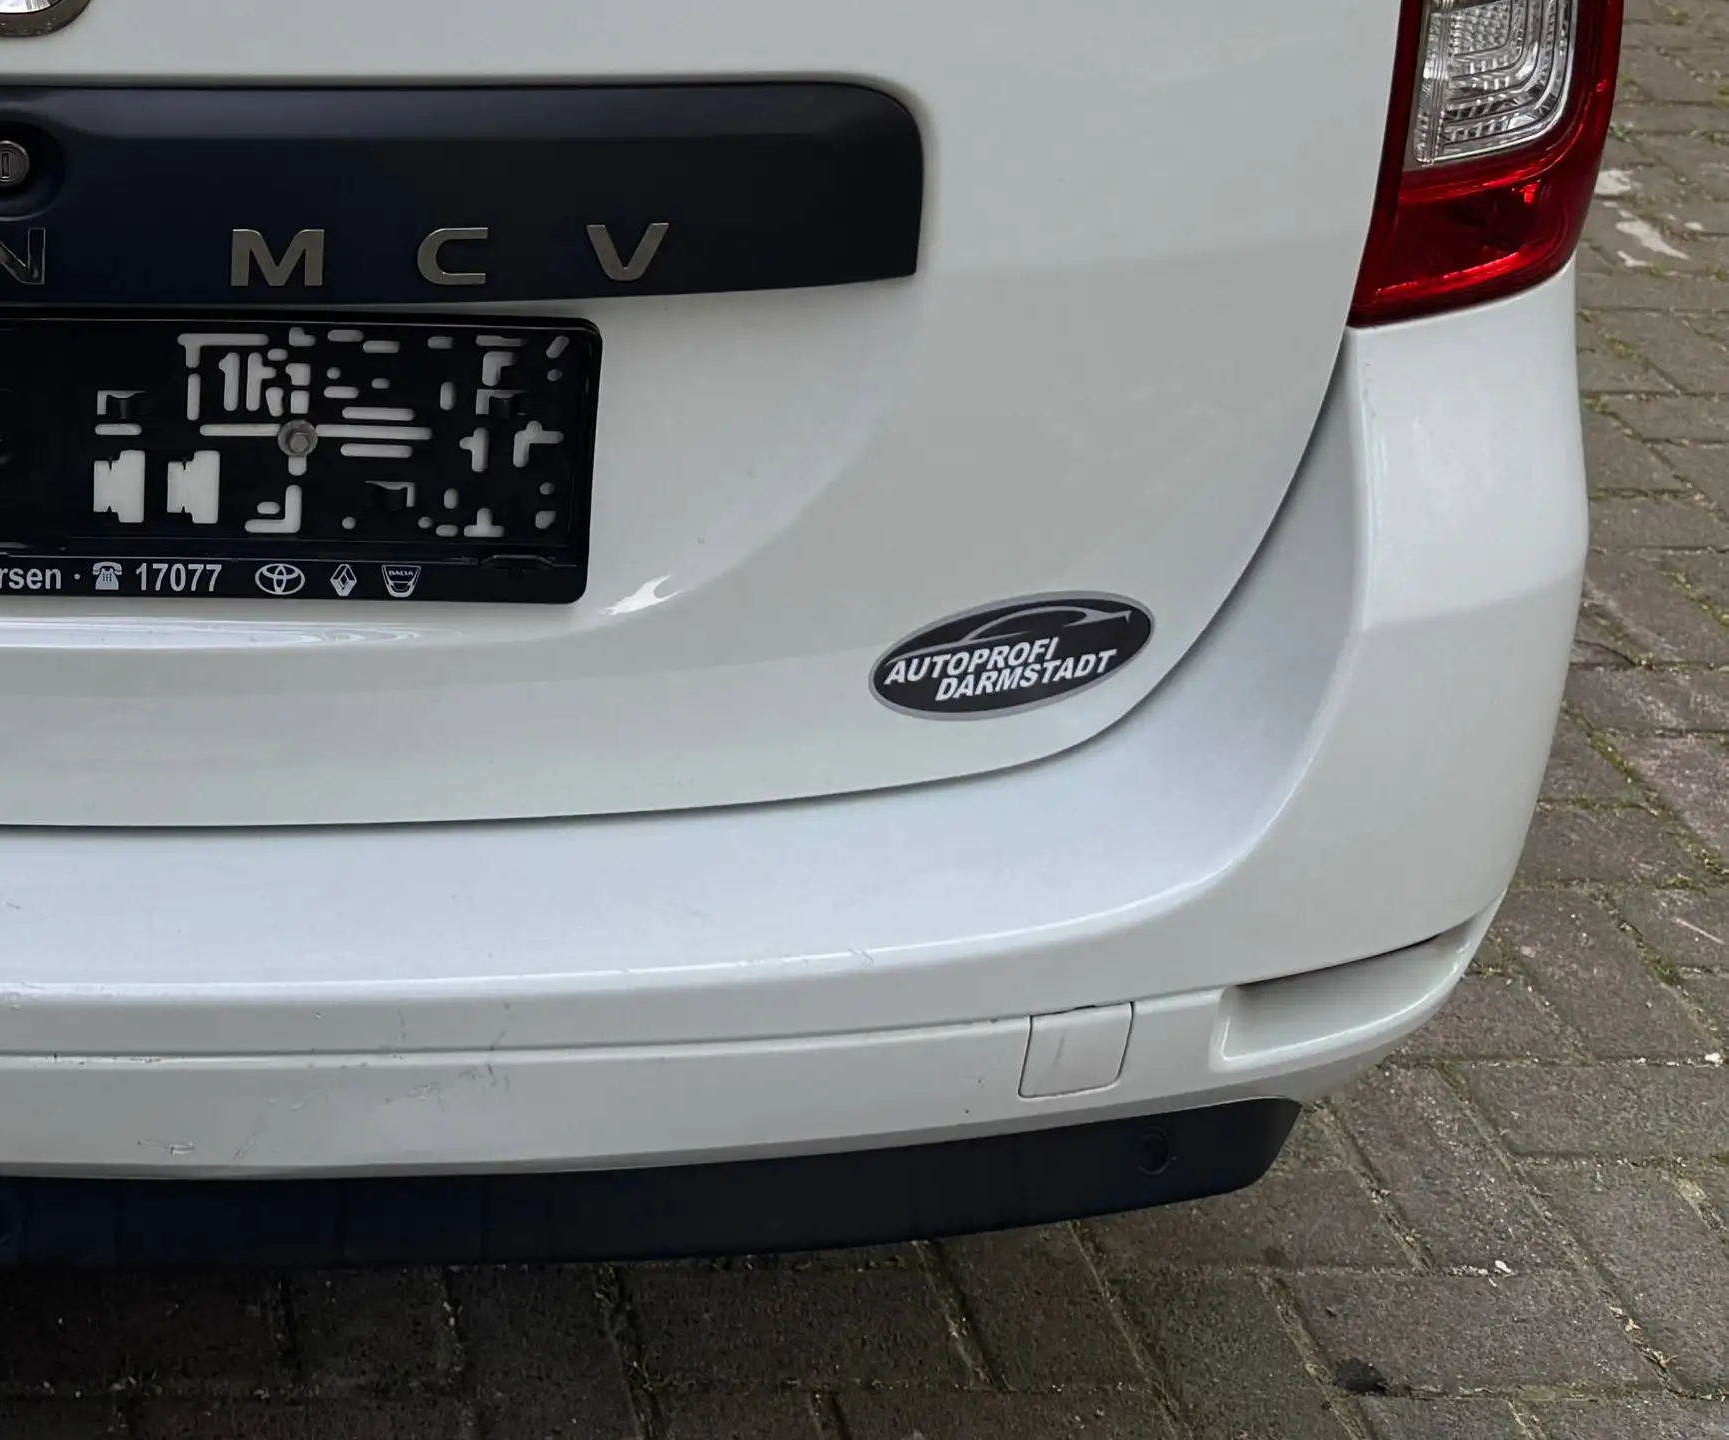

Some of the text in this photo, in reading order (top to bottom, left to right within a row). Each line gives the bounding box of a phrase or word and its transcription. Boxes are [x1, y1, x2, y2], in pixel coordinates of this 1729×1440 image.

[229, 222, 670, 288] MCV
[135, 563, 223, 592] 17077
[883, 636, 1060, 686] AUTOPROFI
[934, 648, 1118, 702] DARMSTADT
